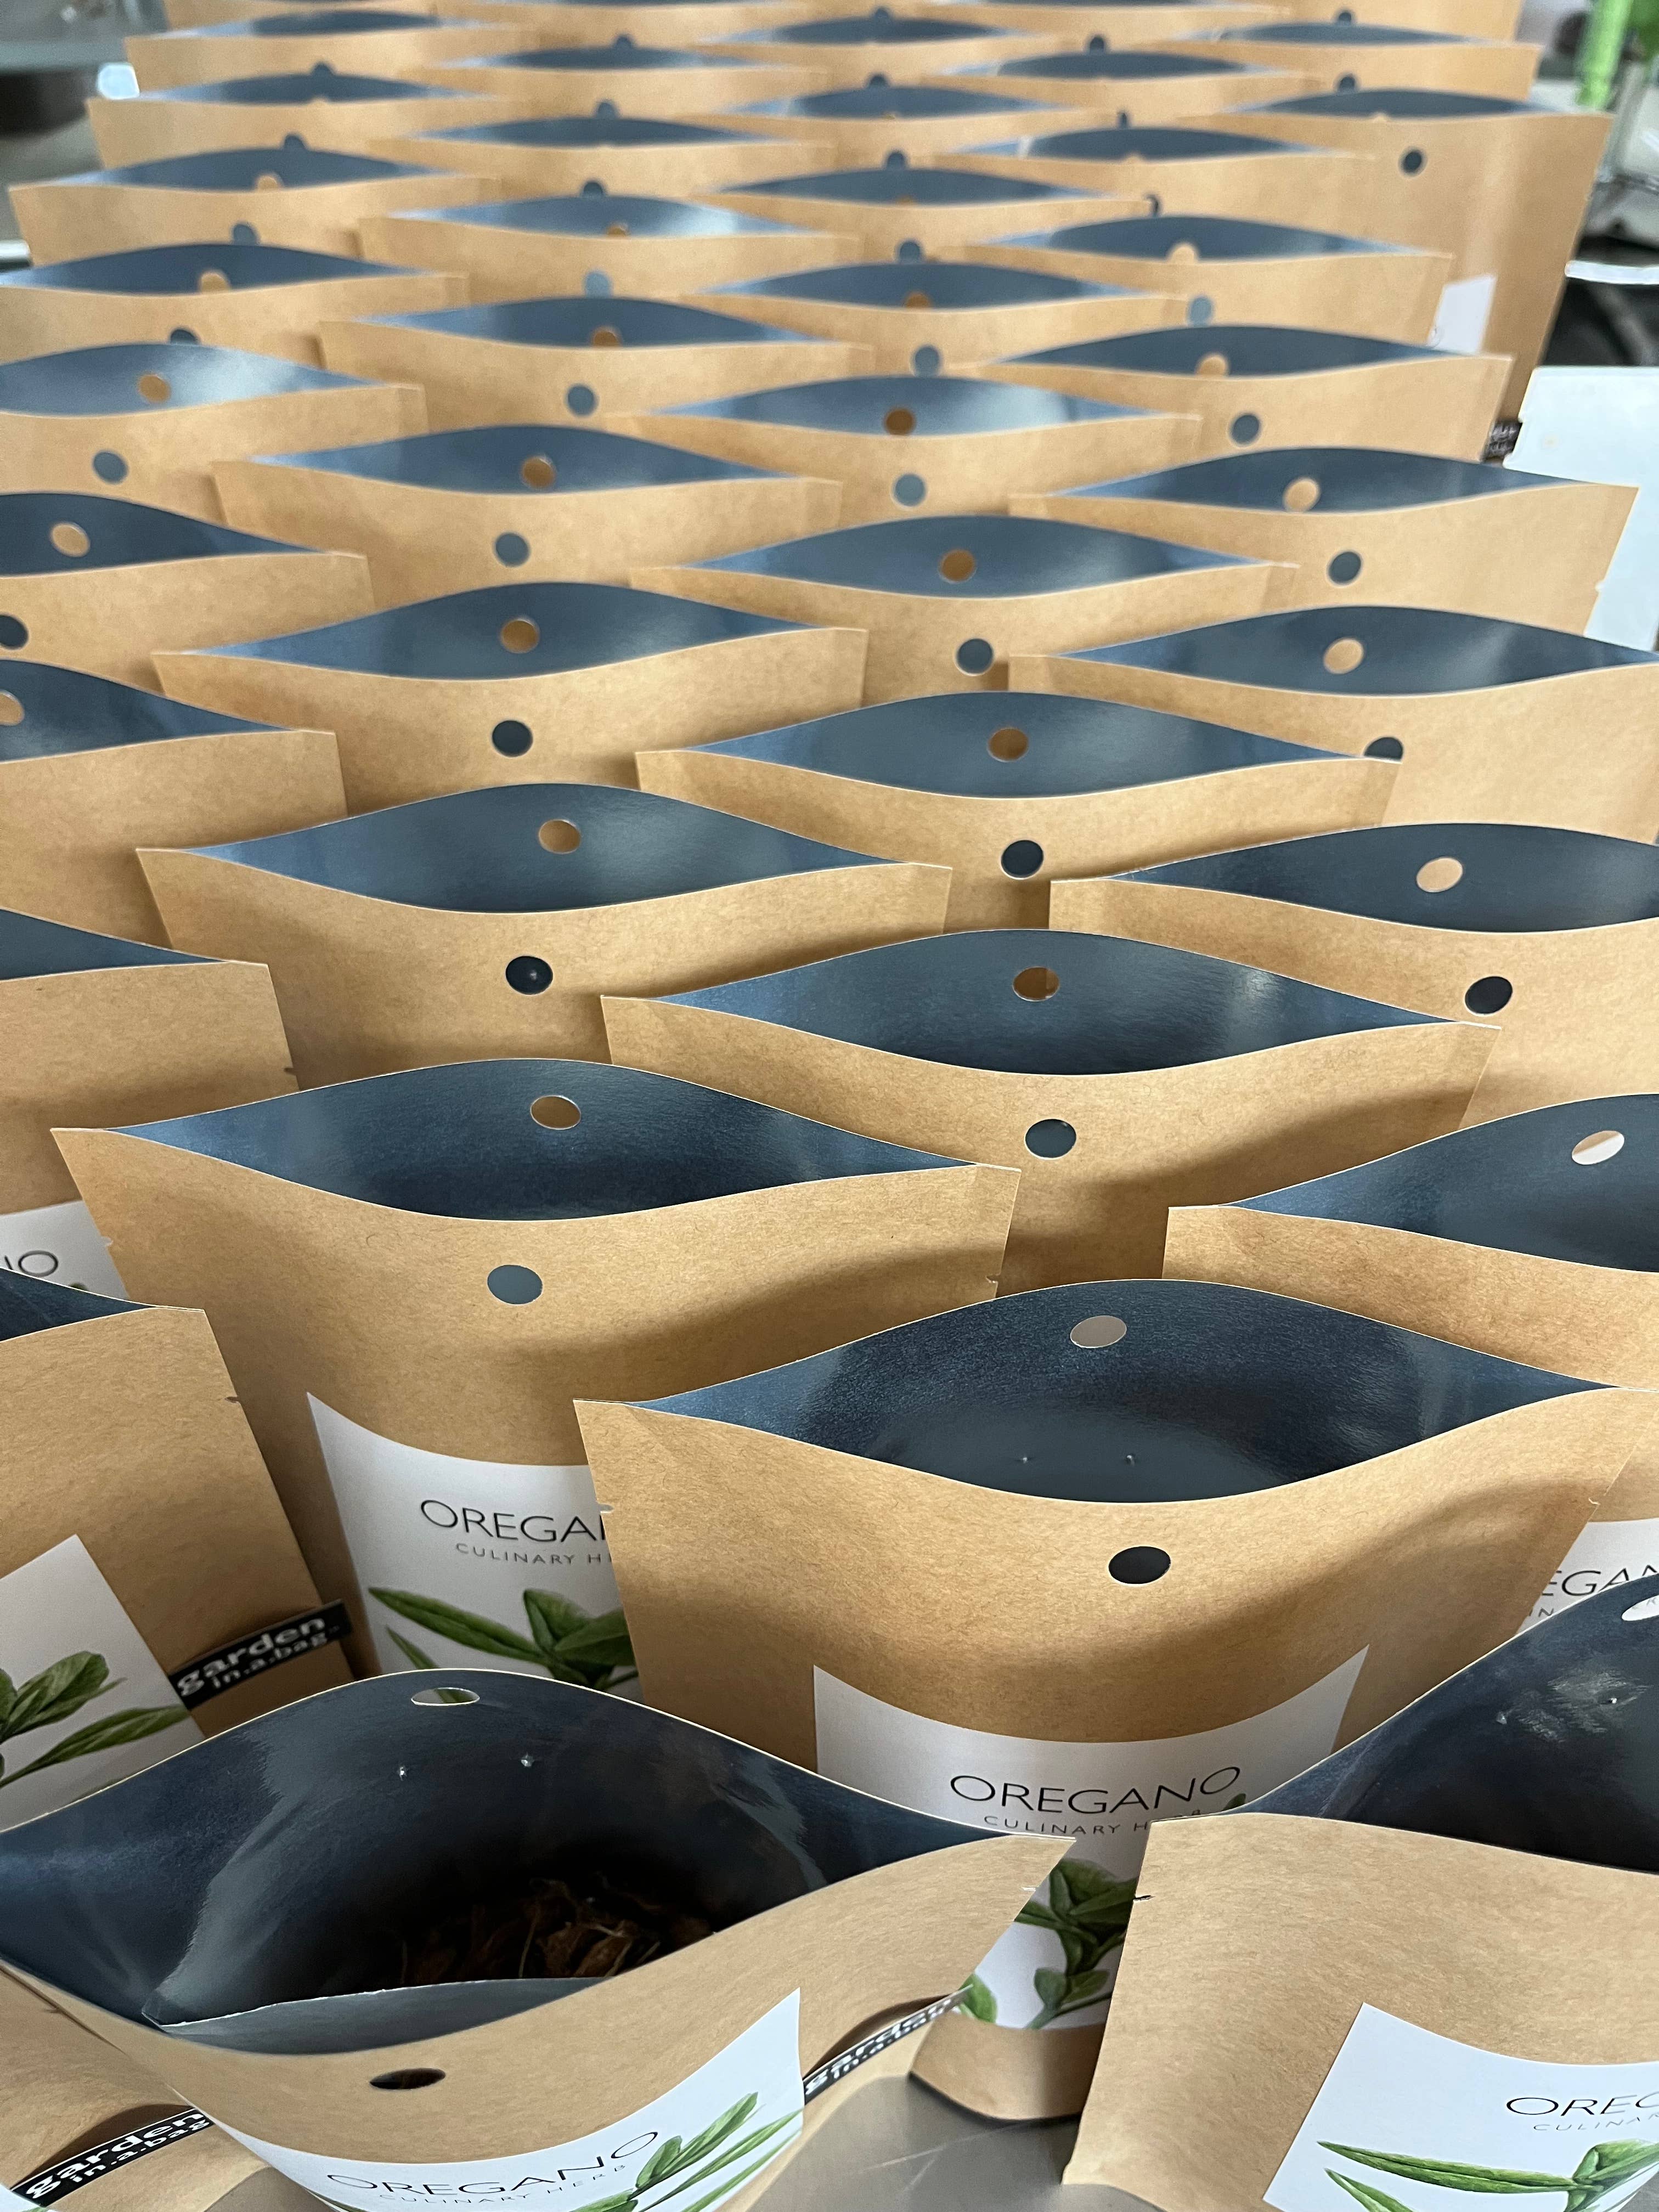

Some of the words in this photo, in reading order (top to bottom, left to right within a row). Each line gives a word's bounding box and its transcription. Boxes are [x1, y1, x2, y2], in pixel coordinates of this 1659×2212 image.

[421, 1499, 606, 1543] OREGA
[456, 1543, 574, 1565] CULINARY
[177, 1618, 326, 1697] garden
[950, 1767, 1240, 1814] OREGANO
[984, 1815, 1121, 1835] CULINARY
[26, 2113, 204, 2199] garden
[327, 2132, 658, 2195] OREGANO
[380, 2193, 531, 2204] CULINARY
[547, 2165, 625, 2194] HERB
